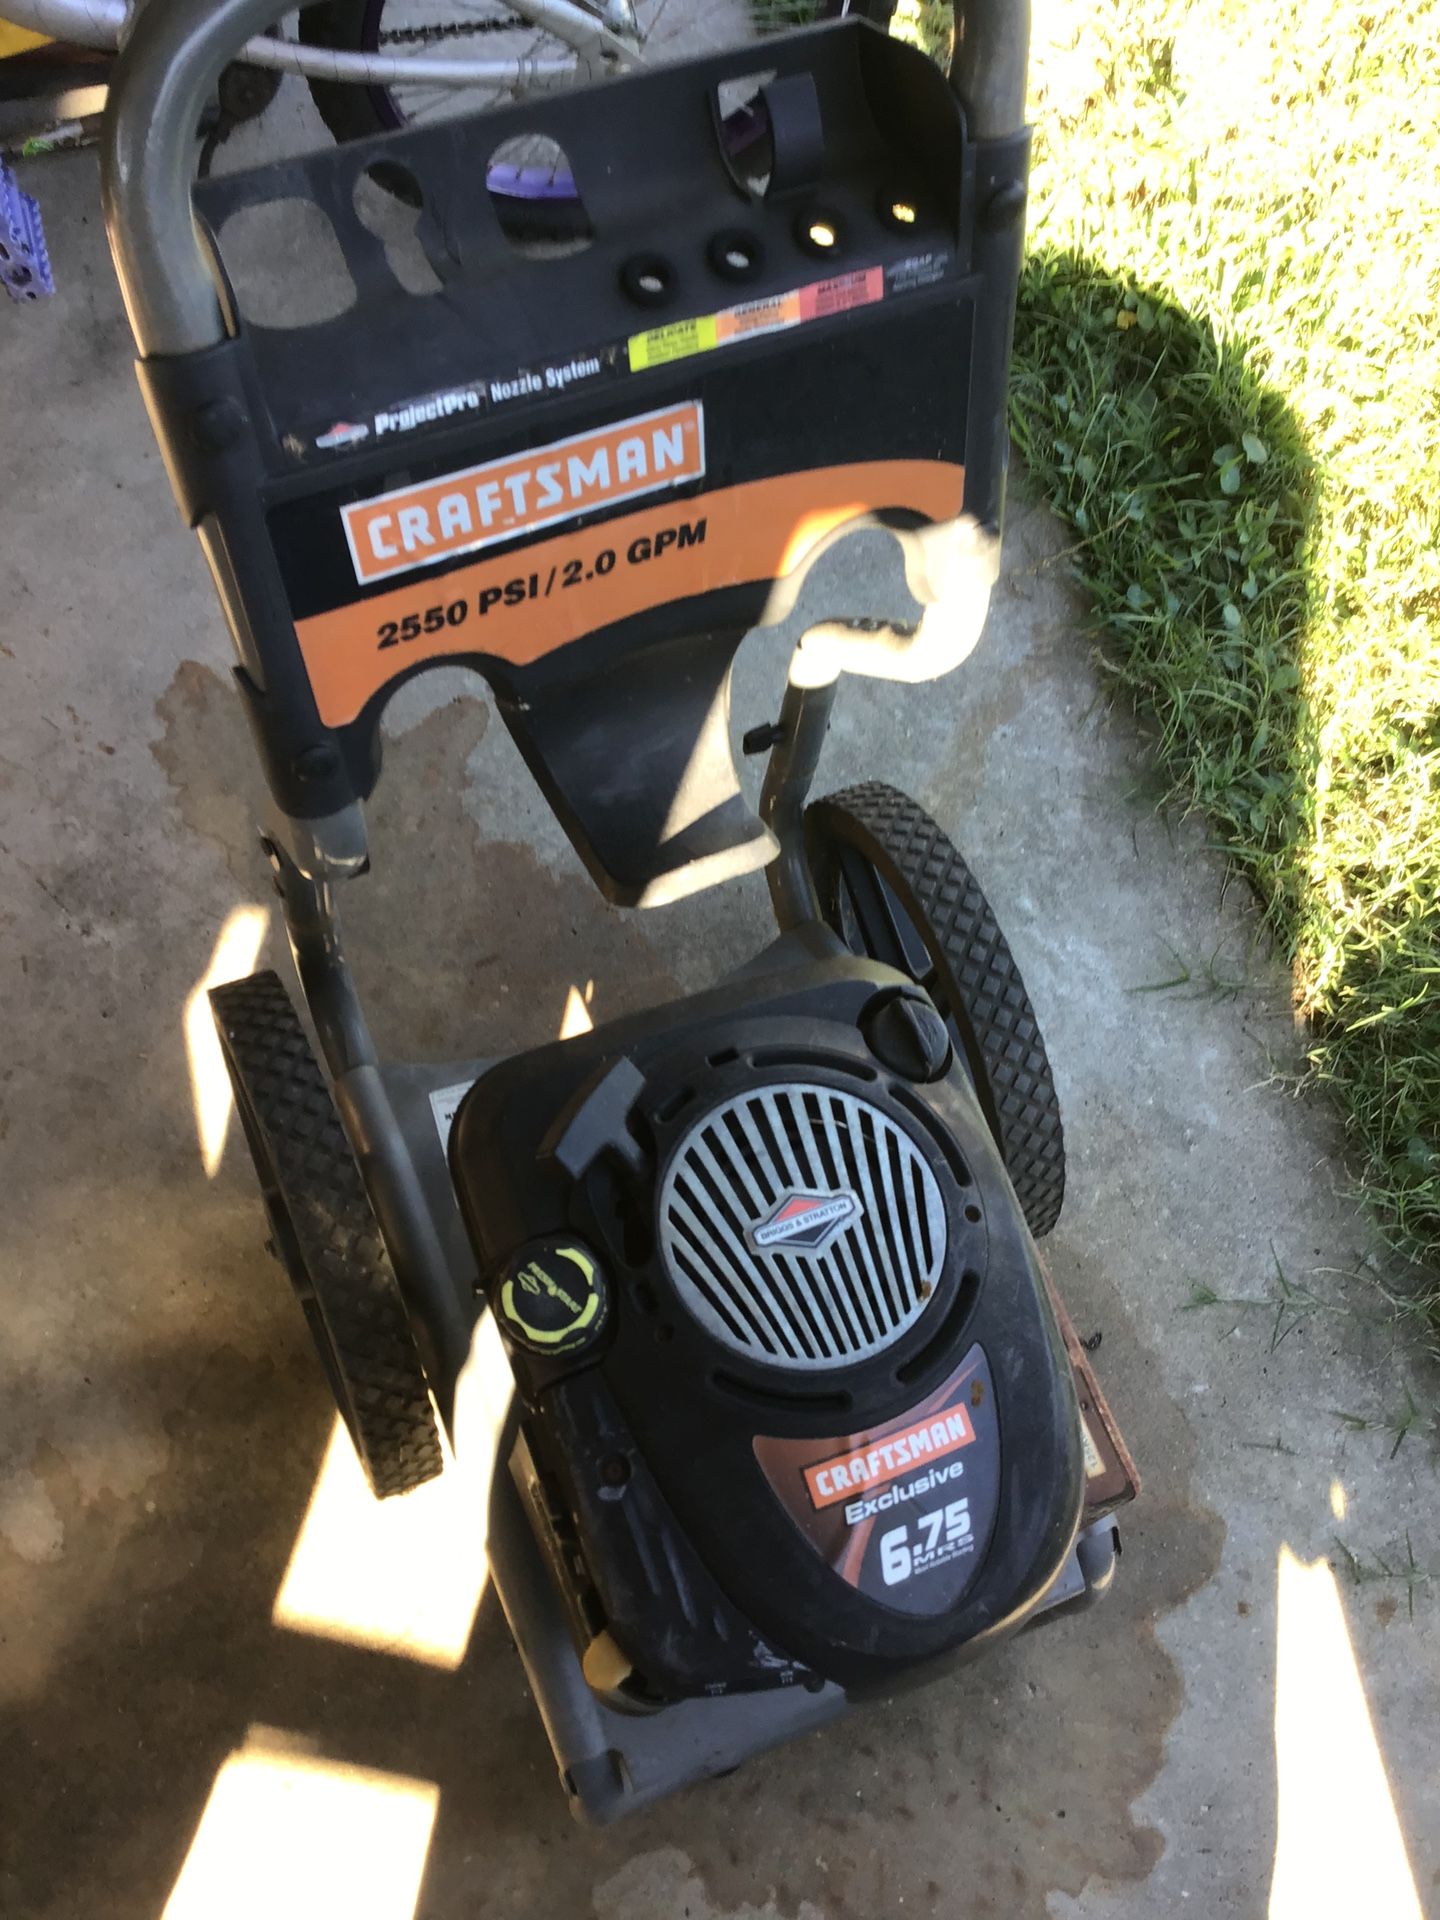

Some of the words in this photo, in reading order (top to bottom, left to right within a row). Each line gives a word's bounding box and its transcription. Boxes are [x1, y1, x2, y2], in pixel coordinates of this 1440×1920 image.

[817, 271, 867, 293] MAXUM
[374, 389, 480, 436] ProjectPro
[490, 372, 543, 403] Nozzle
[545, 355, 601, 390] System
[366, 422, 687, 561] CRAFTSMAN
[375, 599, 469, 651] 2550
[627, 518, 709, 567] GPM
[760, 1223, 795, 1241] BRIGGS
[796, 1218, 803, 1228] &
[804, 1201, 848, 1225] STRATTON
[815, 1412, 968, 1498] CRAFTSMAN
[844, 1461, 965, 1526] Exclusive
[879, 1497, 972, 1587] 6.75
[913, 1534, 975, 1567] MRS
